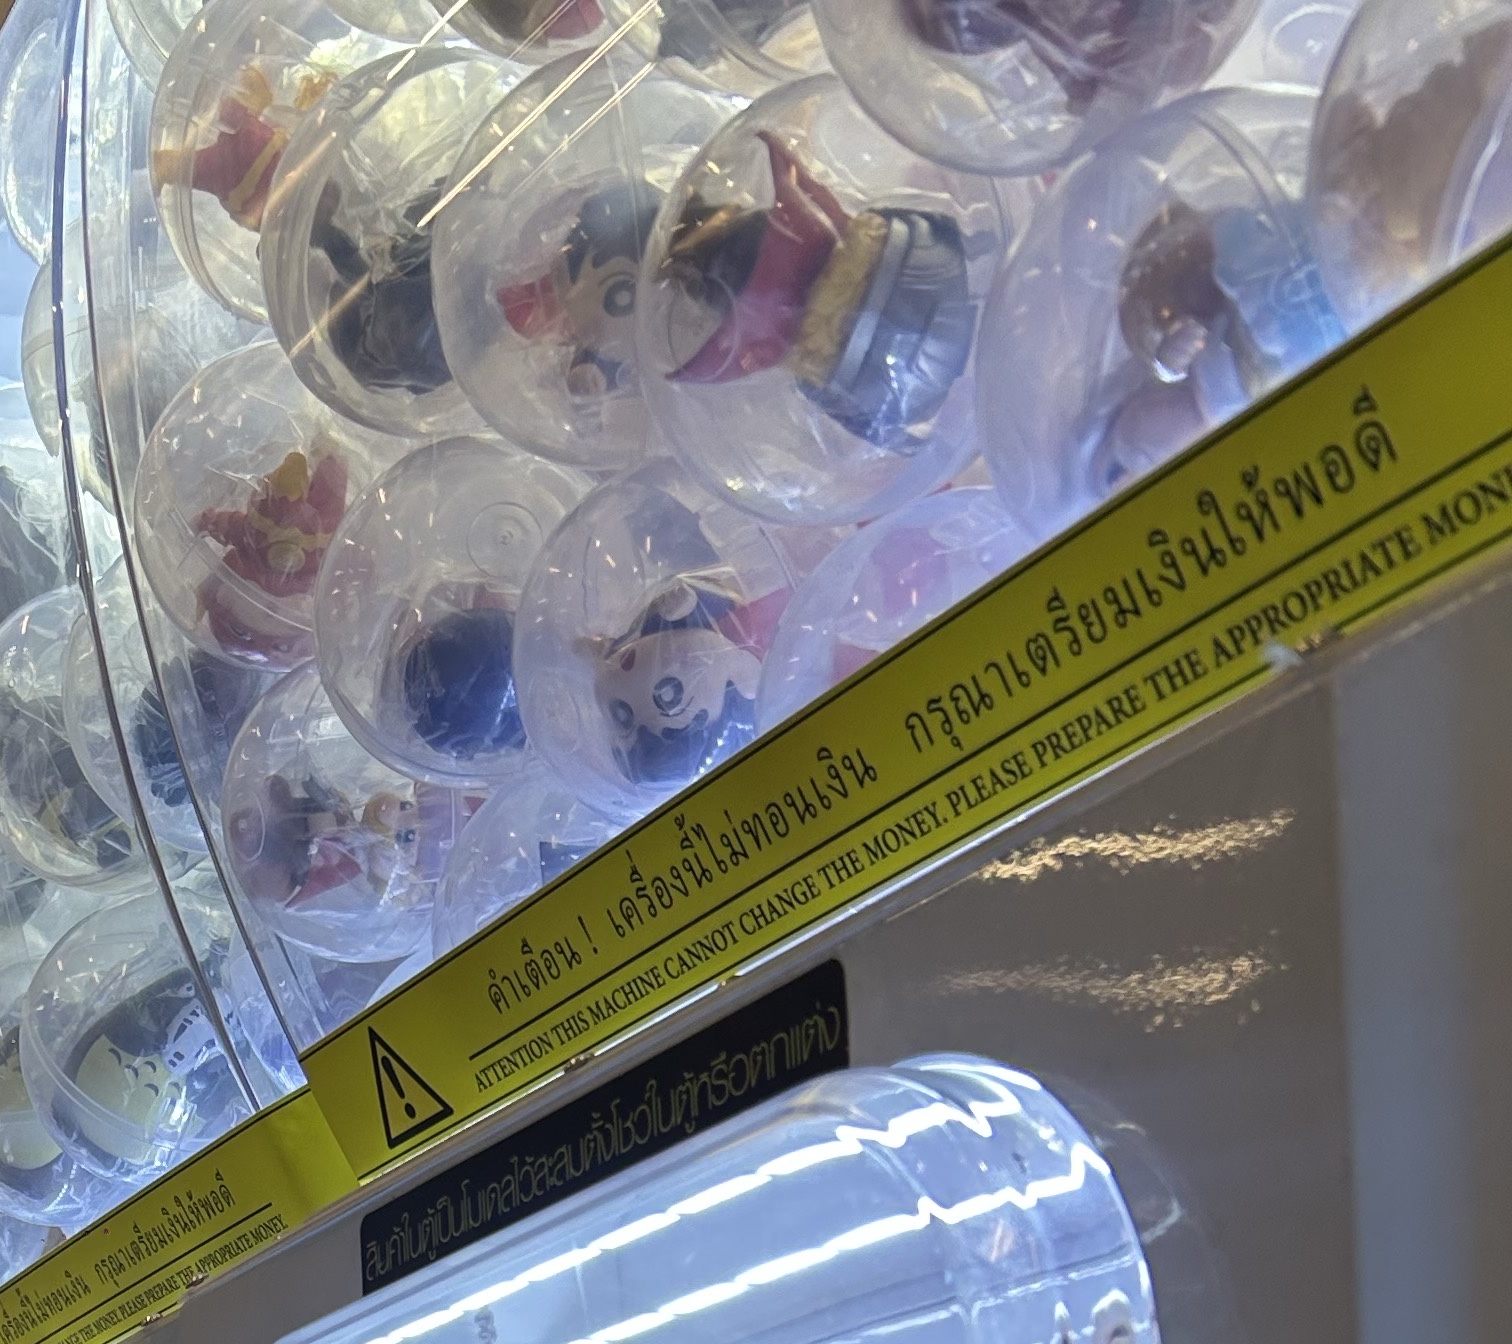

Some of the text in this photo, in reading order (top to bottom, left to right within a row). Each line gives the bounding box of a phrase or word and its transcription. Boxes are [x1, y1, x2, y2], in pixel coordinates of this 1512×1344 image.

[905, 384, 1398, 753] กรุณาเตรียมเงินให้พอดี
[473, 1032, 555, 1092] ATTENTION
[552, 1010, 590, 1045] THIS
[587, 966, 666, 1026] MACHINE
[663, 920, 740, 981] CANNOT
[738, 871, 822, 936] CHANGE
[817, 850, 865, 889] THE
[863, 801, 949, 865] MONEY.
[946, 750, 1033, 818] PLEASE
[1031, 685, 1147, 768] PREPARE
[1143, 645, 1209, 703] THE
[1212, 525, 1423, 669] APPROPRIATE
[118, 1294, 148, 1320] PLEASE
[144, 1277, 182, 1305] PREPARE
[195, 1232, 254, 1276] APPROPRIATE
[252, 1213, 289, 1245] MONEY.
